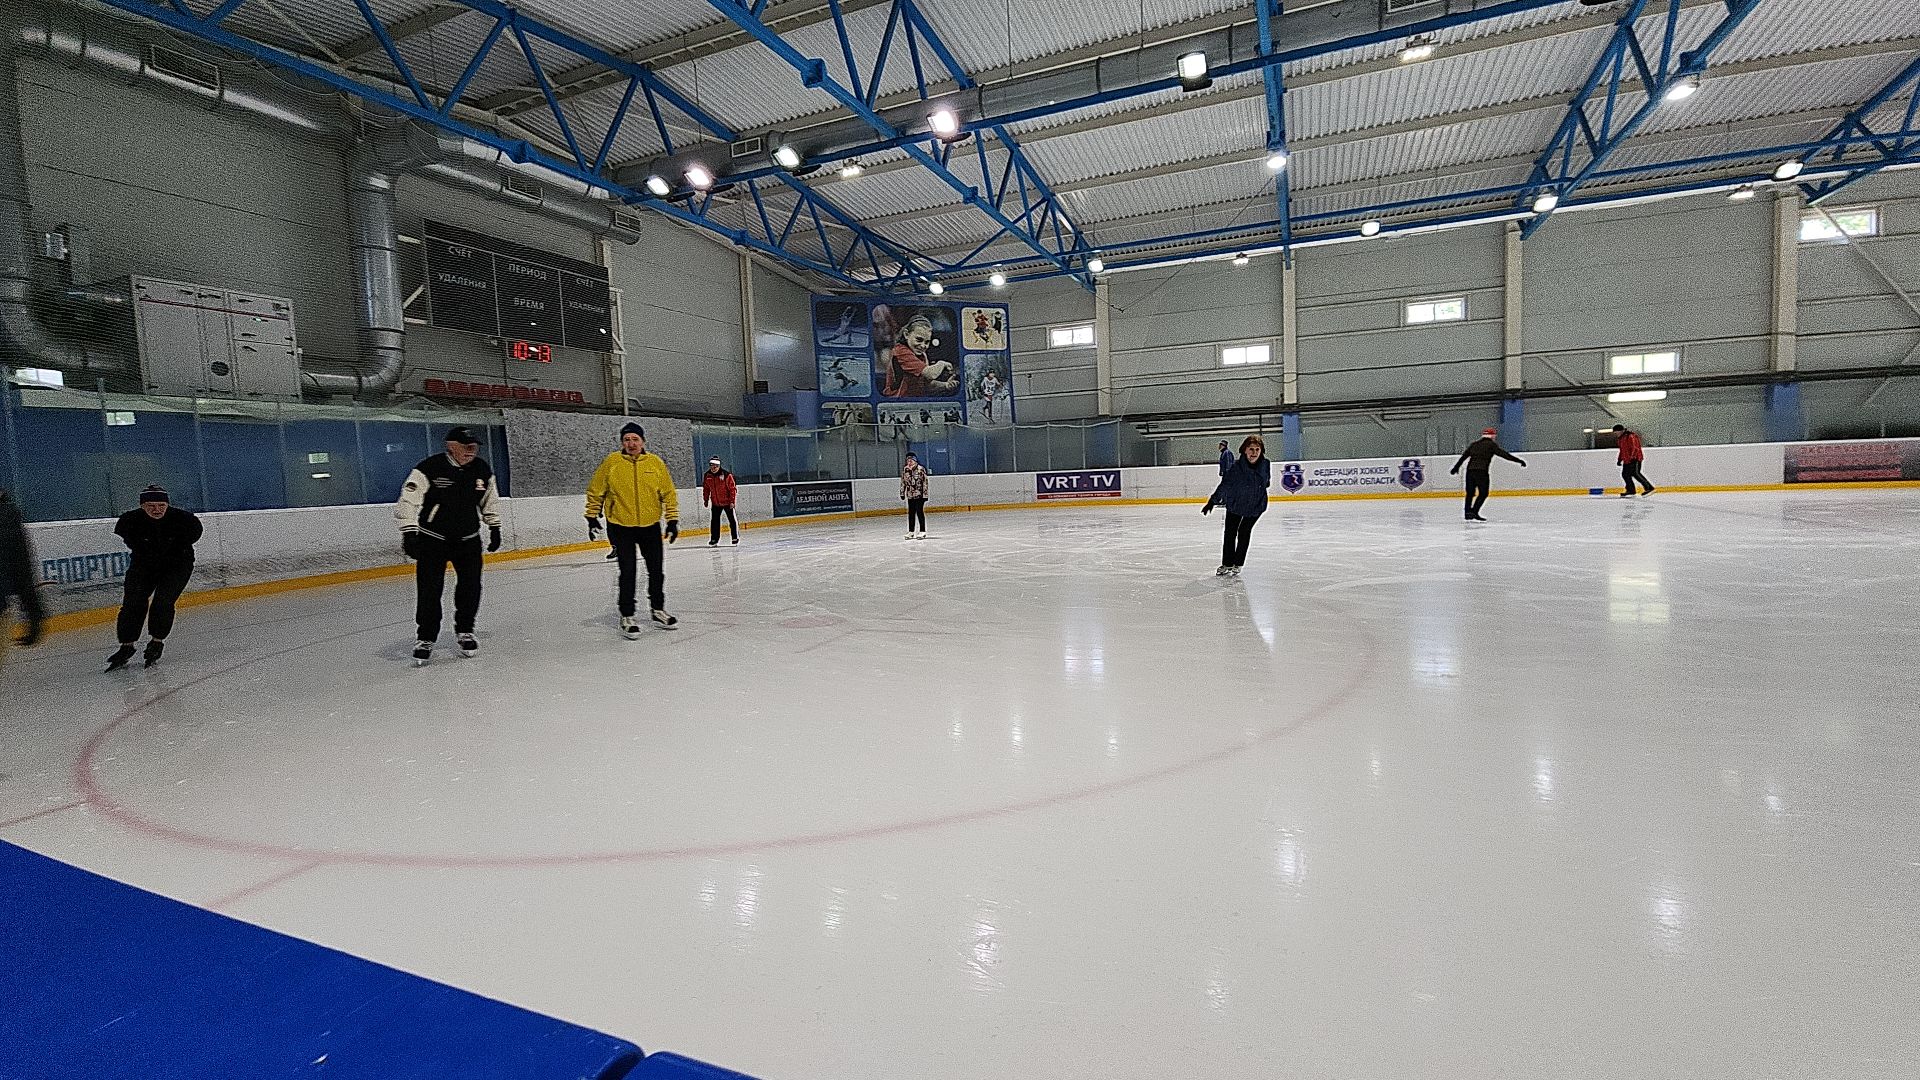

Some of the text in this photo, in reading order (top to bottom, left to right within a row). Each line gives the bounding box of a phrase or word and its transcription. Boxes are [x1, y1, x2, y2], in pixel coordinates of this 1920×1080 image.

[508, 263, 547, 280] ПЕРИОД
[438, 272, 487, 289] УДАЛЕНИЯ
[513, 297, 545, 310] ВРЕМЯ
[1313, 466, 1358, 477] ФЕДЕРАЦИЯ
[1360, 466, 1389, 475] ХОККЕЯ
[1308, 476, 1395, 487] МОСКОВСКОЙ ОБЛАСТИ
[796, 493, 850, 503] ЛЕДЯНОЙ АНГЕЛ
